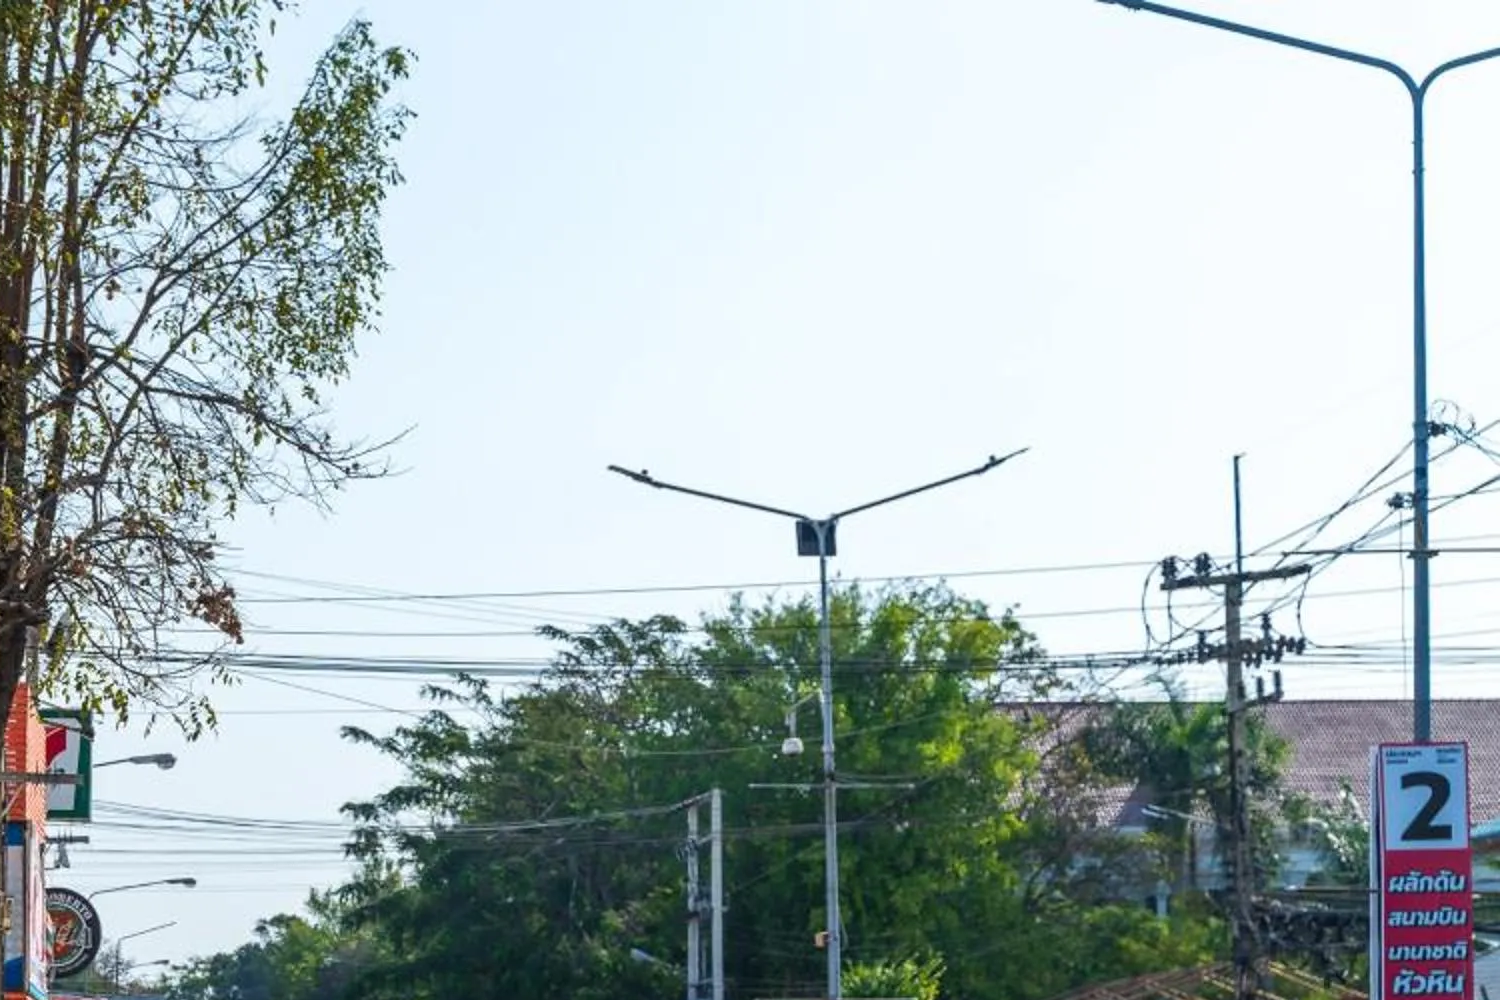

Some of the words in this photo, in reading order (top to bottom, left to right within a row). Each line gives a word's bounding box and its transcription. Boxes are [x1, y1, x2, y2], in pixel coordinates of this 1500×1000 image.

[1400, 771, 1453, 840] 2
[1389, 870, 1465, 893] ผลักดัน
[1388, 906, 1467, 926] สนามบิน
[1388, 941, 1468, 960] นานาชาติ
[1393, 968, 1465, 994] หัวหิน
